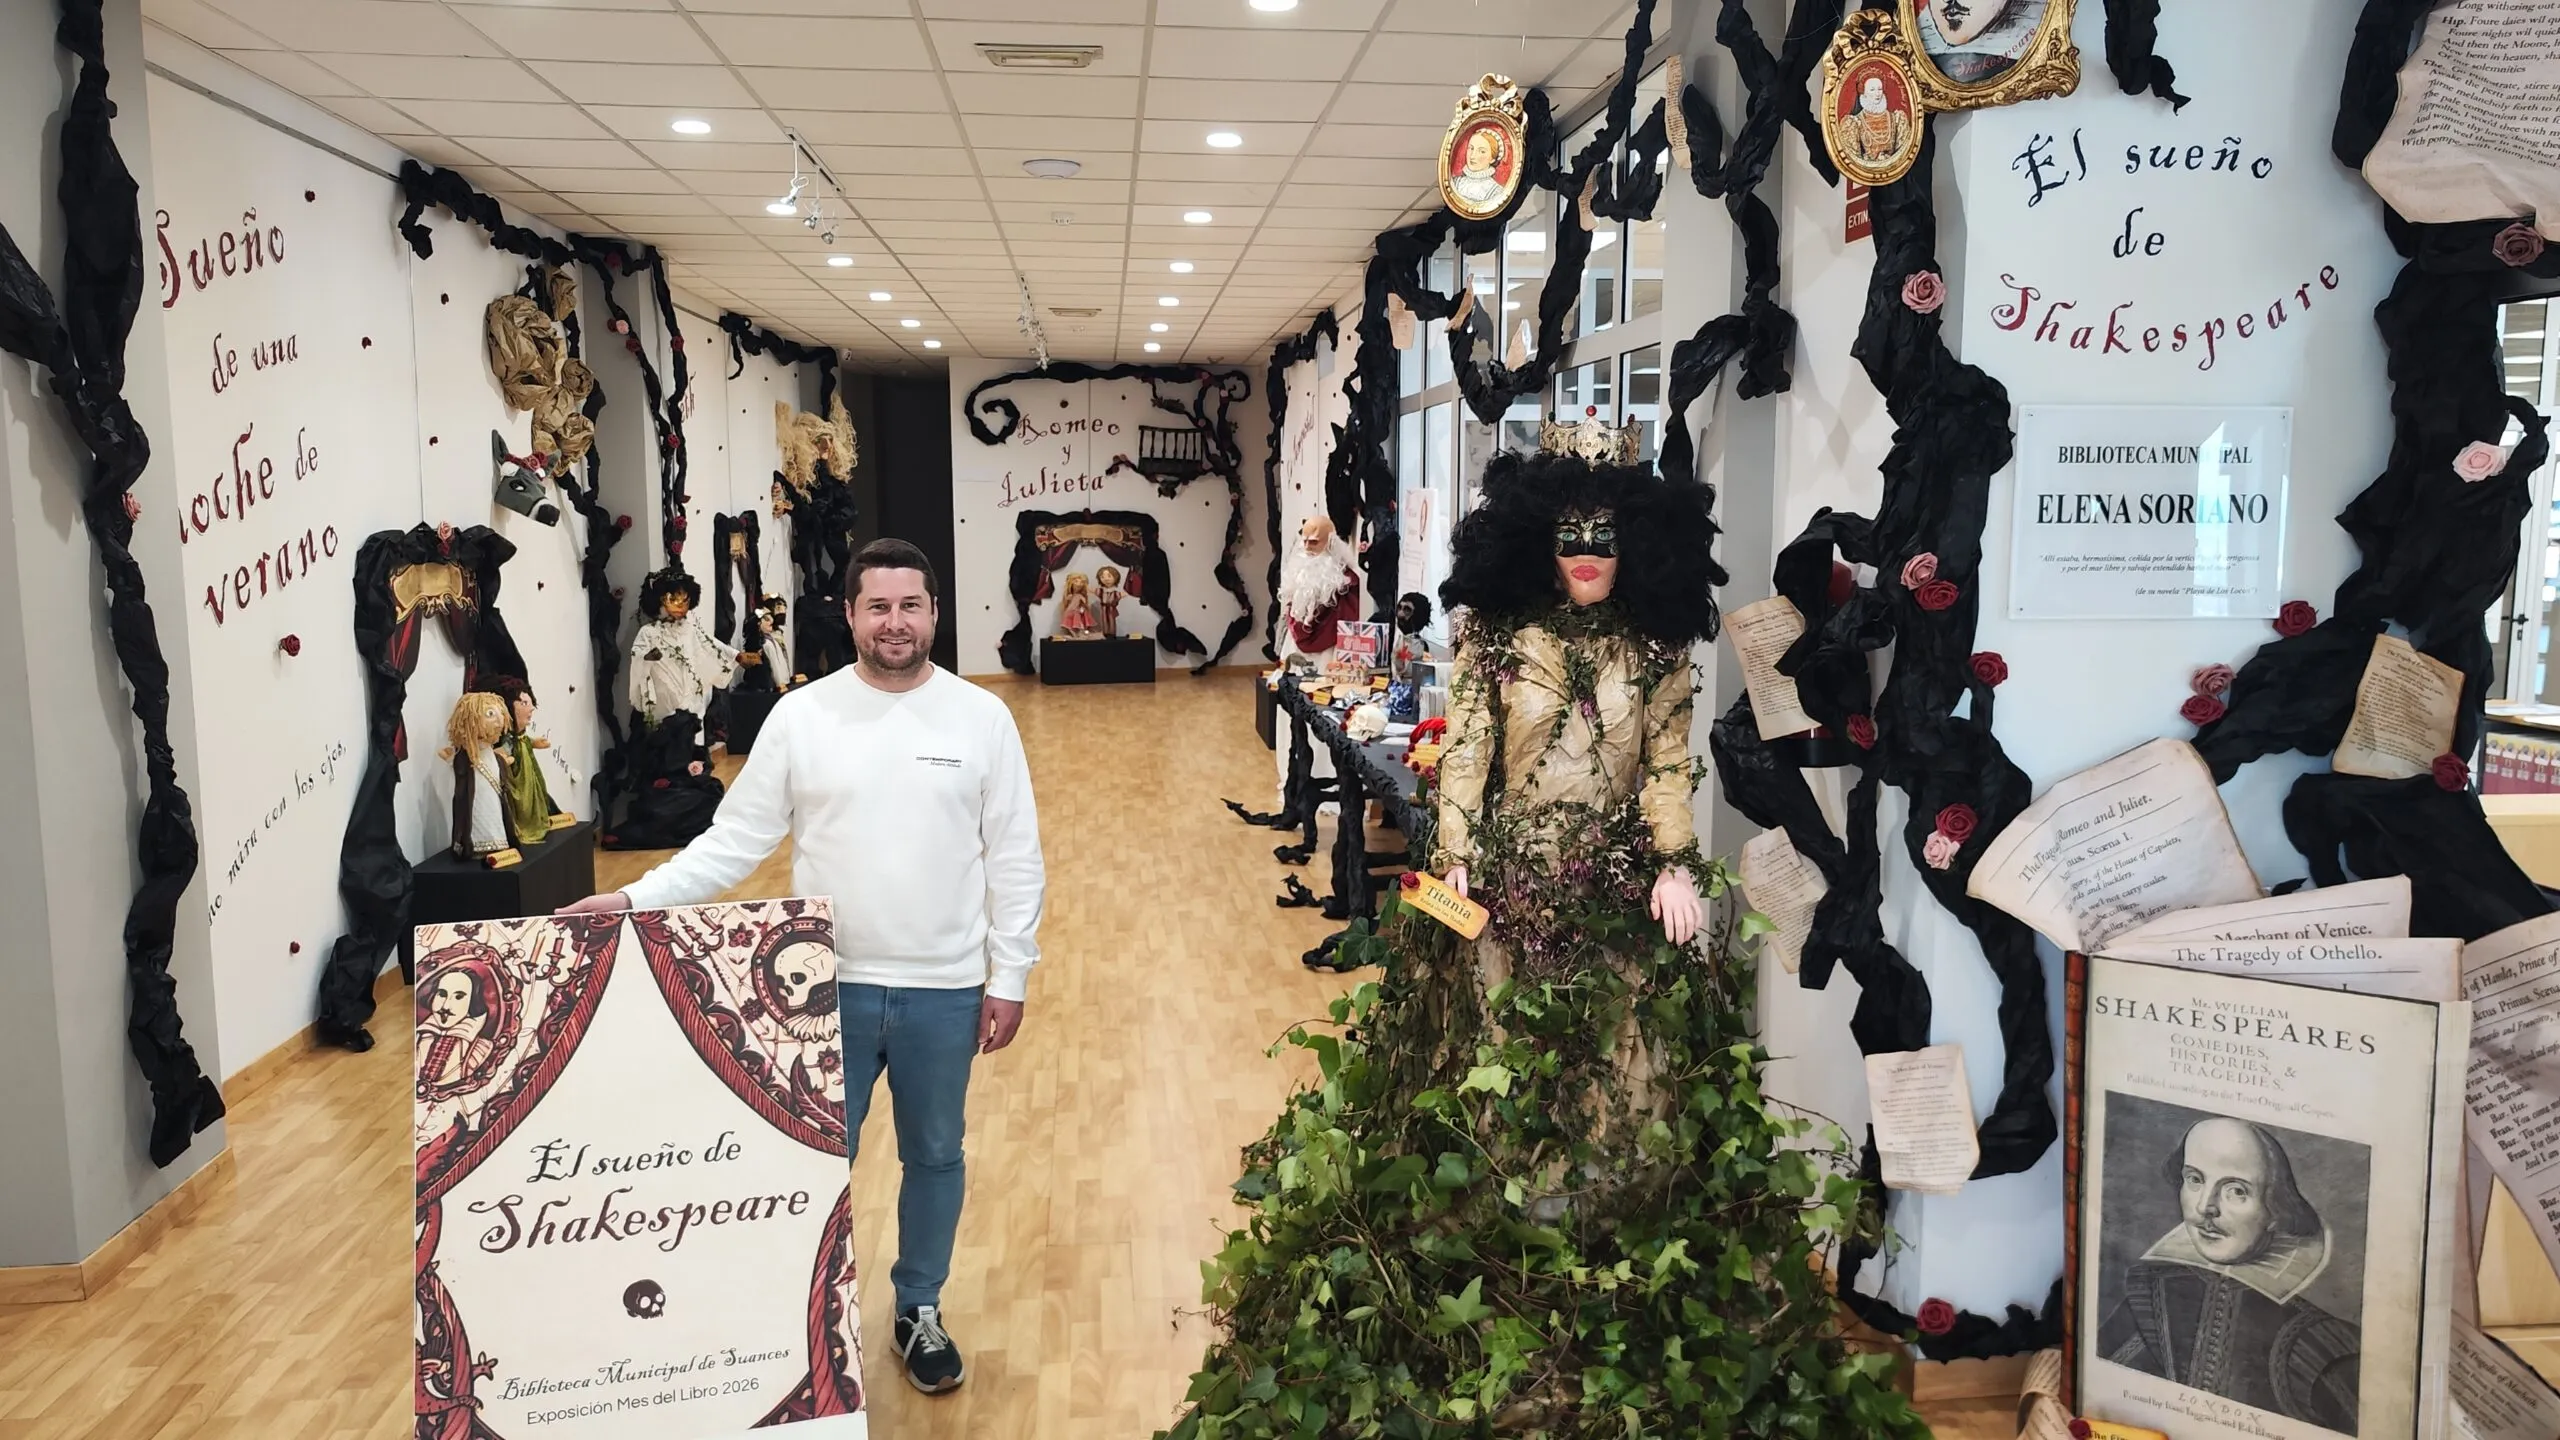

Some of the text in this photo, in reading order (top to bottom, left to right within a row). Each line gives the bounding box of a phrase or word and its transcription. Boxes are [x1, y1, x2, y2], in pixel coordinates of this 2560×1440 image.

[2442, 16, 2466, 27] Hip.
[2470, 16, 2500, 26] Foure
[2487, 1, 2535, 12] withering
[2443, 38, 2465, 48] And
[2467, 40, 2489, 49] then
[2448, 28, 2479, 37] Foure
[2481, 29, 2512, 39] nights
[2490, 52, 2500, 60] in
[2422, 58, 2550, 90] The. stirre
[2429, 68, 2526, 101] Awake the and
[2440, 96, 2461, 105] pale
[2463, 103, 2517, 121] companion
[2520, 113, 2529, 121] is
[2532, 115, 2549, 123] not
[2456, 89, 2511, 111] melancholy
[2512, 103, 2539, 112] forth
[2413, 112, 2431, 125] And
[2466, 123, 2483, 134] thy
[2499, 122, 2521, 133] thee
[2522, 124, 2546, 136] with
[2011, 127, 2273, 208] El sueño
[1848, 209, 1869, 229] EXTIN
[2113, 207, 2166, 259] de
[156, 205, 285, 311] Sueño
[1990, 263, 2340, 371] Shakespeare
[211, 333, 298, 395] de una
[1018, 414, 1120, 445] Romeo
[295, 426, 318, 482] de
[1061, 444, 1071, 465] y
[2058, 445, 2253, 464] BIBLIOTECA MUNIPAL
[997, 466, 1104, 508] Julieta
[2036, 493, 2269, 525] ELENA SORIANO
[204, 524, 338, 626] verano
[226, 740, 347, 885] mira con los ojos,
[2094, 806, 2116, 826] and
[2118, 794, 2153, 819] Juliet.
[2114, 856, 2138, 871] House
[1426, 885, 1472, 921] Titania
[2295, 924, 2311, 940] of
[2313, 922, 2373, 938] Venice.
[2171, 944, 2382, 966] The Tragedy of Othello.
[2469, 978, 2481, 993] of
[2518, 957, 2546, 974] Prince
[2548, 947, 2559, 967] of
[2095, 995, 2377, 1055] SHAKESPEARES
[2214, 1001, 2289, 1020] WILLIAM
[2169, 1046, 2297, 1079] HISTORIES, &
[2170, 1033, 2270, 1060] COMEDIES,
[2169, 1060, 2285, 1092] TRAGEDIES.
[2489, 1126, 2514, 1139] Fran.
[2497, 1138, 2520, 1151] Bar.
[526, 1131, 742, 1183] El sueño de
[2506, 1149, 2531, 1163] Fran.
[467, 1185, 811, 1254] Shakespeare
[497, 1347, 791, 1401] Biblioteca Municipal de Suances
[527, 1377, 760, 1426] Exposición Mes del Libro 2026
